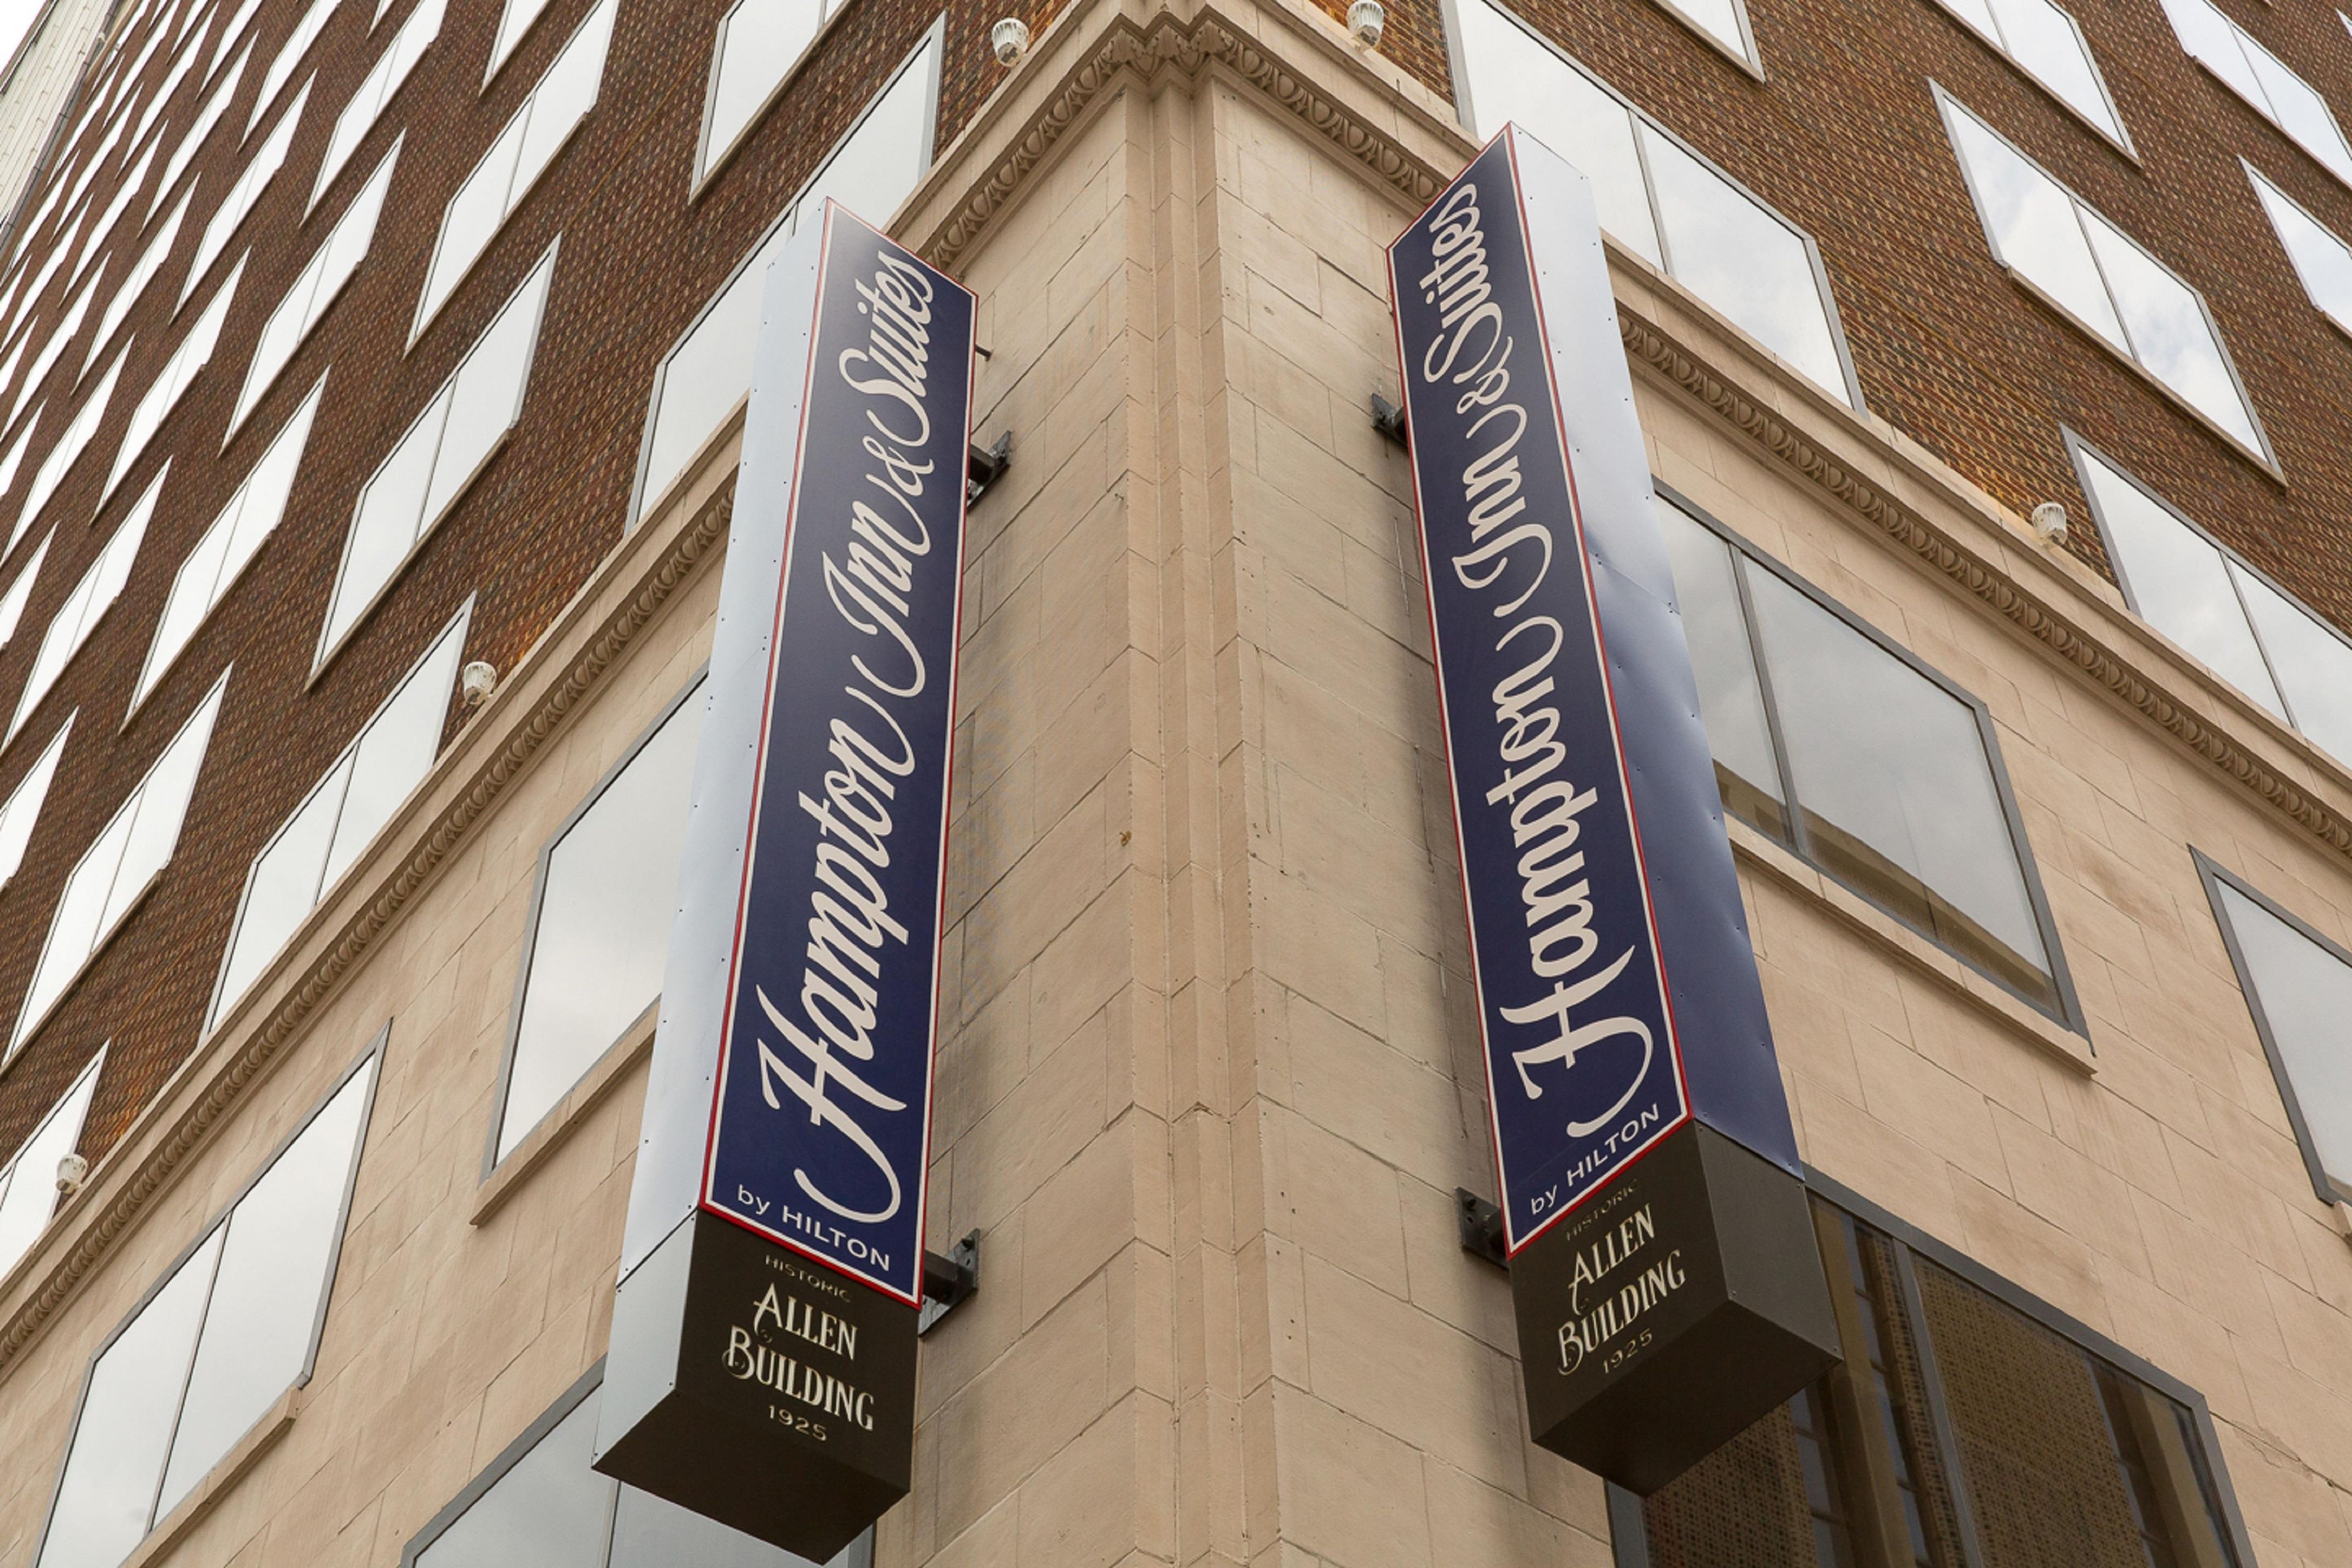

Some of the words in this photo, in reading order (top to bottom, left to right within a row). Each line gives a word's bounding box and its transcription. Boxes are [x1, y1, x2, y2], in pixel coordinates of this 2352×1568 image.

[1419, 183, 1503, 384] Suites
[839, 250, 934, 448] Suites
[1456, 336, 1513, 415] &
[861, 435, 935, 497] &
[1451, 403, 1553, 617] Inn
[821, 473, 931, 698] Inn
[1485, 616, 1653, 1137] Hampton
[756, 685, 915, 1223] Hampton
[1531, 1184, 1558, 1216] by
[1566, 1102, 1660, 1187] HILTON
[1564, 1178, 1639, 1242] HISTORIC
[737, 1184, 771, 1215] by
[783, 1205, 890, 1272] HILTON
[764, 1254, 852, 1303] HISTORIC
[1566, 1202, 1655, 1316] ALLEN
[753, 1282, 859, 1362] ALLEN
[1556, 1248, 1686, 1376] BUILDING
[1602, 1327, 1653, 1374] 1925
[721, 1324, 875, 1432] BUILDING
[768, 1404, 828, 1442] 1925
